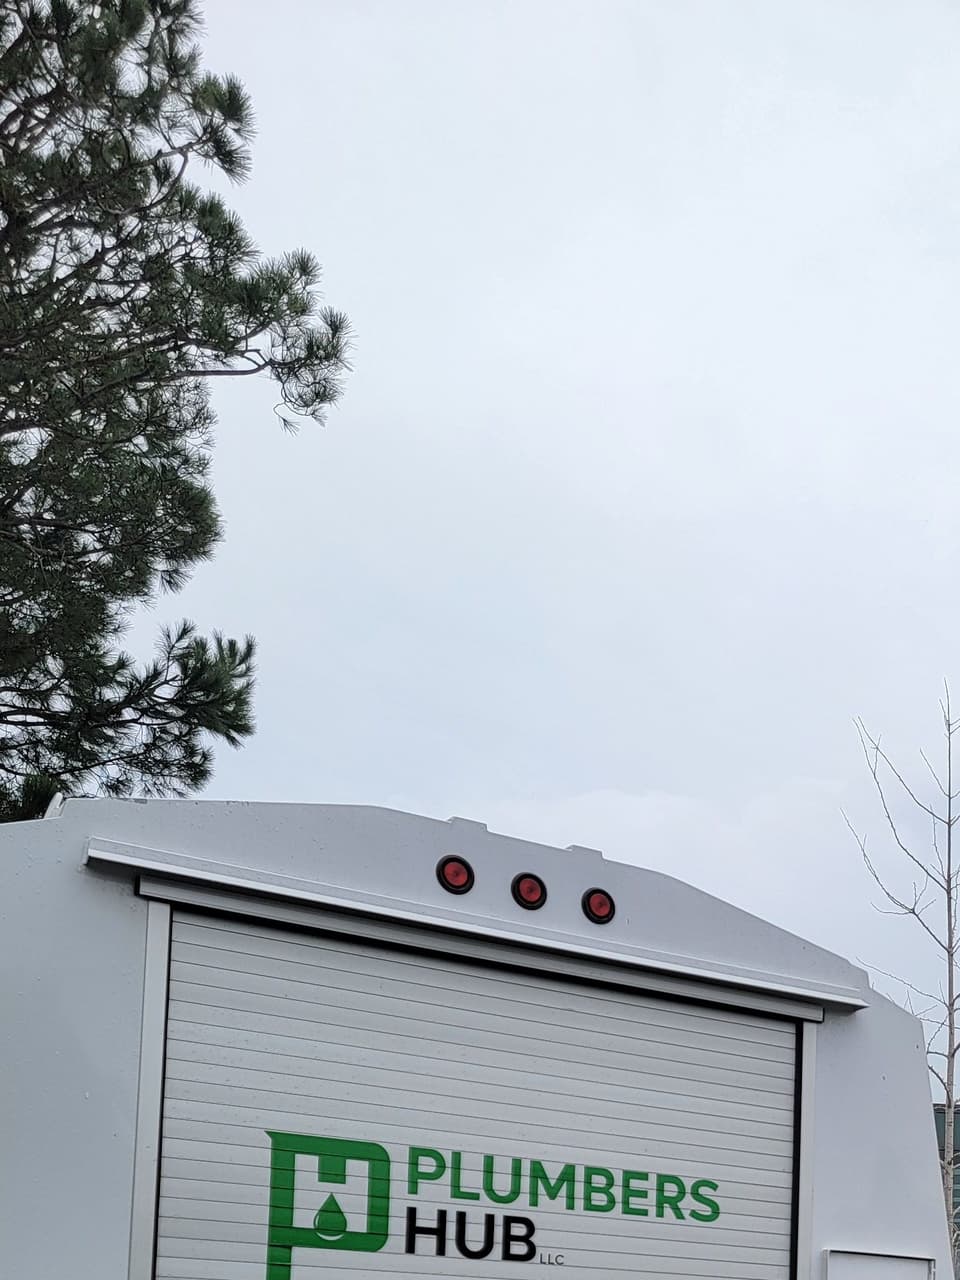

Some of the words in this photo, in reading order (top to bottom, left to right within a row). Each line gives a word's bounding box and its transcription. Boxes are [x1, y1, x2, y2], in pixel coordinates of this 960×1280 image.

[407, 1146, 720, 1223] PLUMBERS
[404, 1206, 537, 1263] HUB
[539, 1253, 565, 1266] LLC
